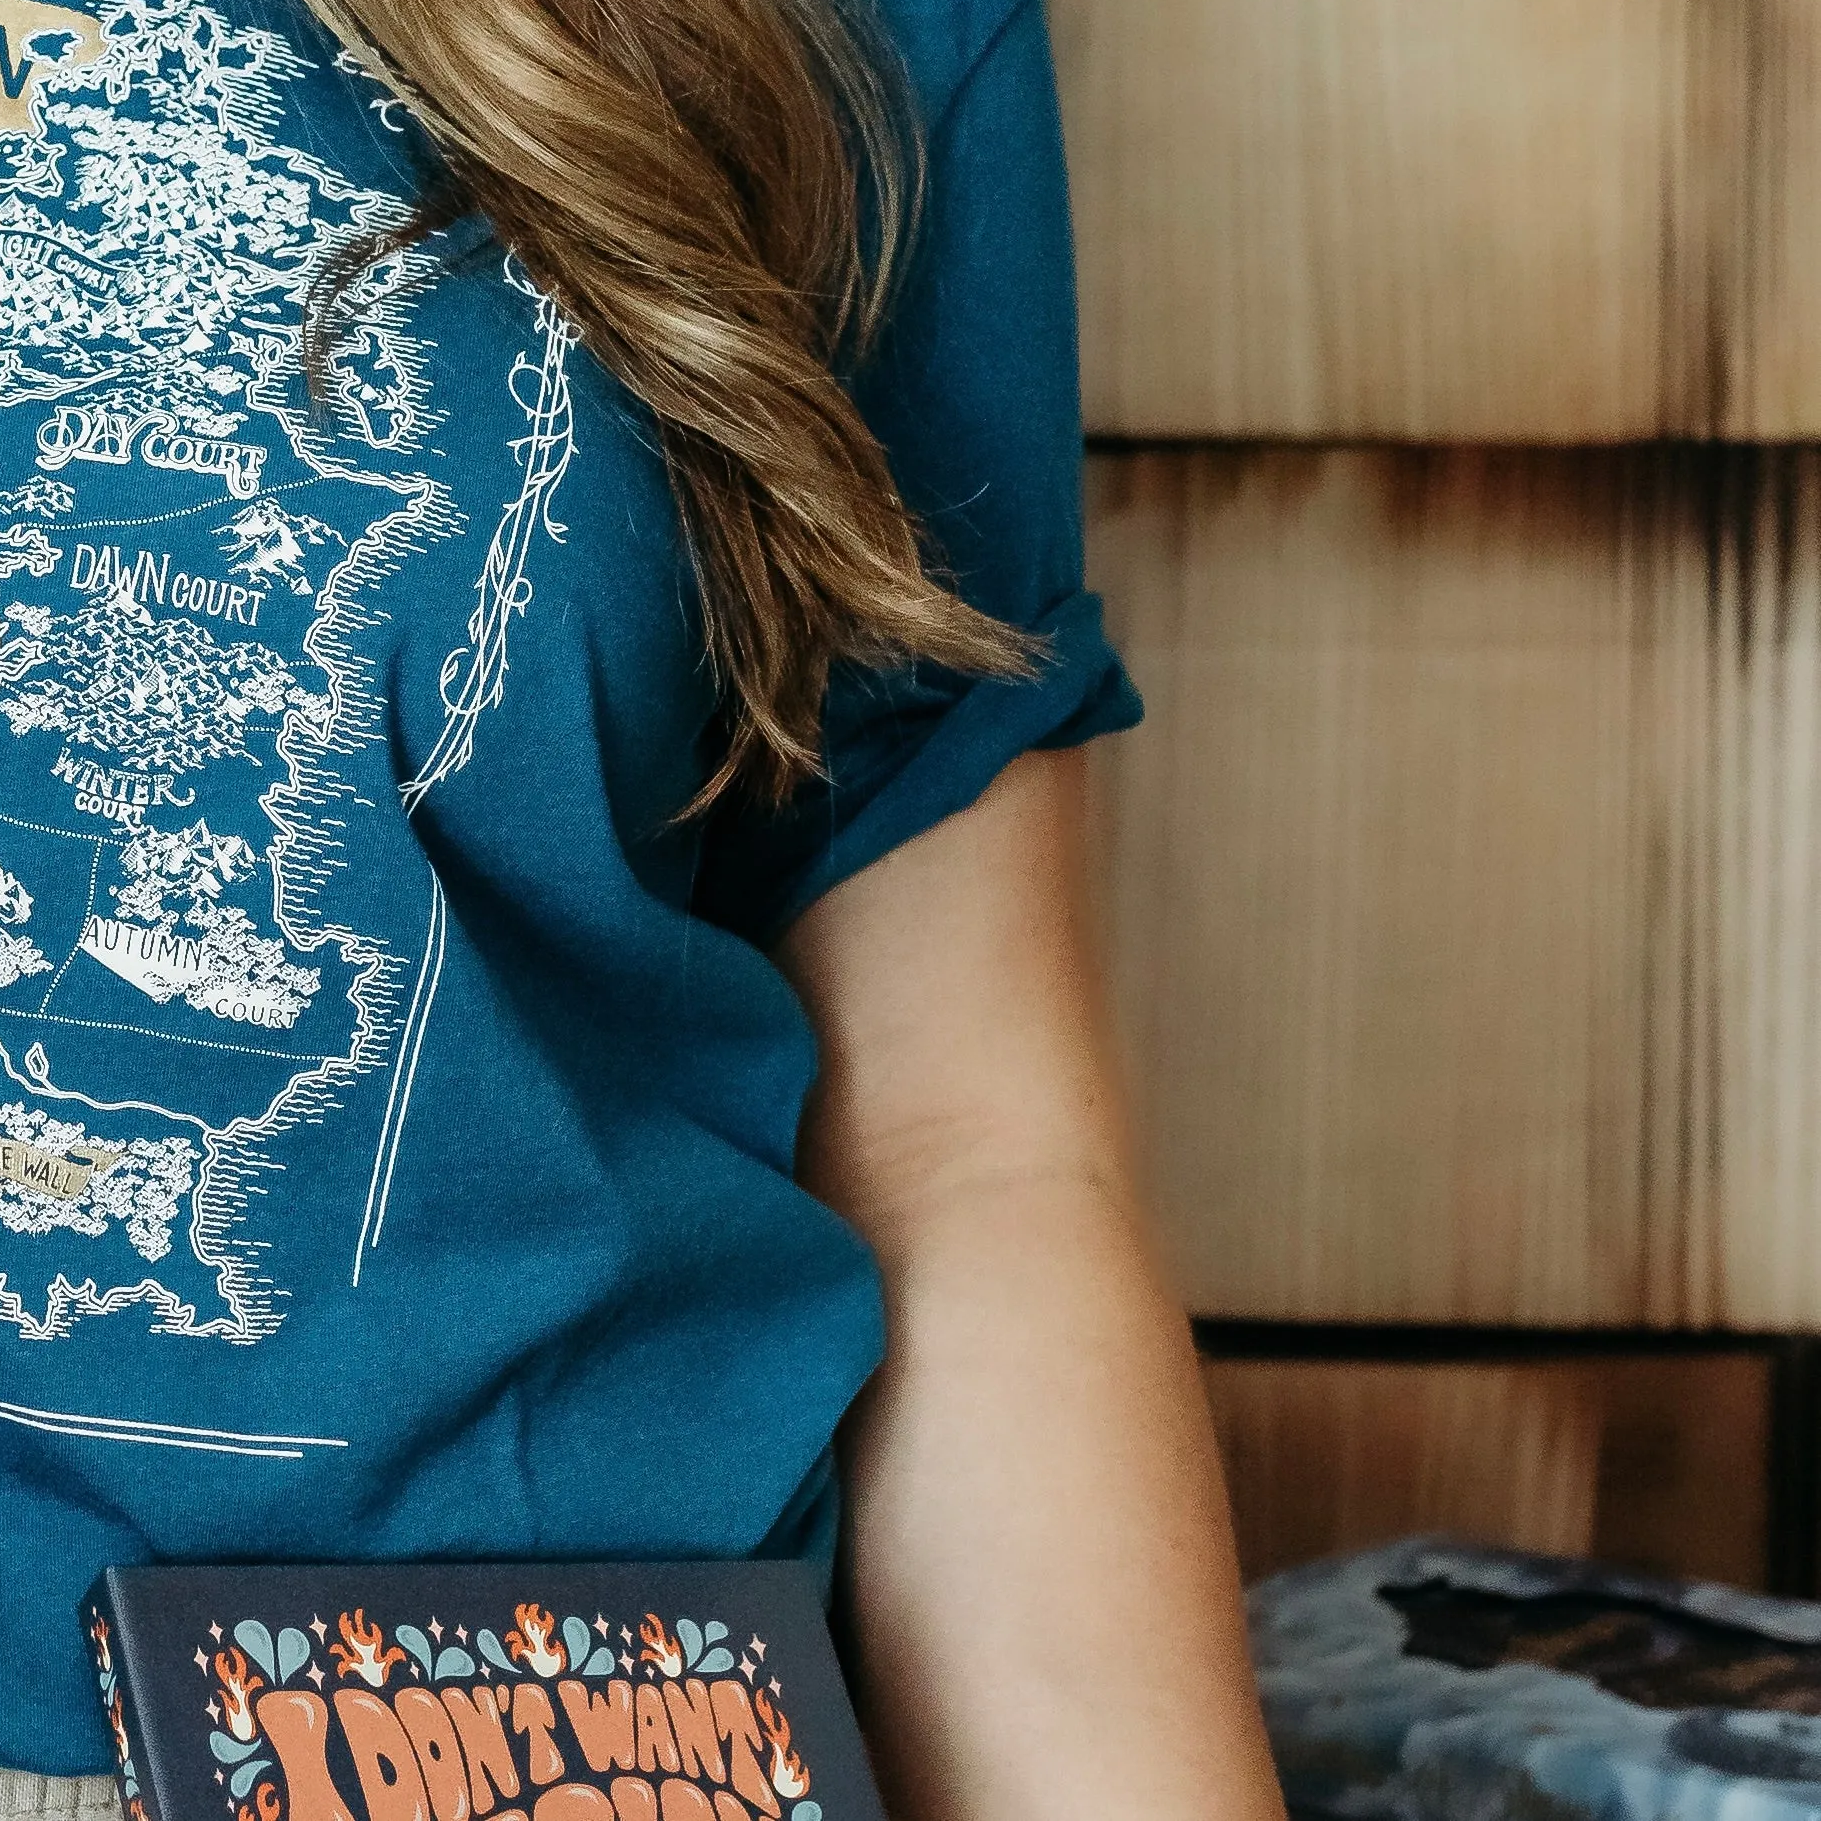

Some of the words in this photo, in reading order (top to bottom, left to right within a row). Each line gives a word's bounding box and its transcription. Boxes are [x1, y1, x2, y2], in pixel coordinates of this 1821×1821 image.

[54, 254, 116, 292] COURT
[36, 406, 179, 470] DAY
[142, 434, 266, 499] COURT
[70, 544, 170, 605] DAWN
[172, 573, 266, 627] COURT
[50, 747, 195, 807] WINTER
[75, 791, 146, 834] COURT
[82, 917, 203, 971] AUTUMN
[214, 998, 298, 1028] COURT
[23, 1152, 73, 1195] WALL
[256, 1689, 354, 1821] I
[334, 1682, 565, 1821] DON'T
[558, 1679, 780, 1819] WANT
